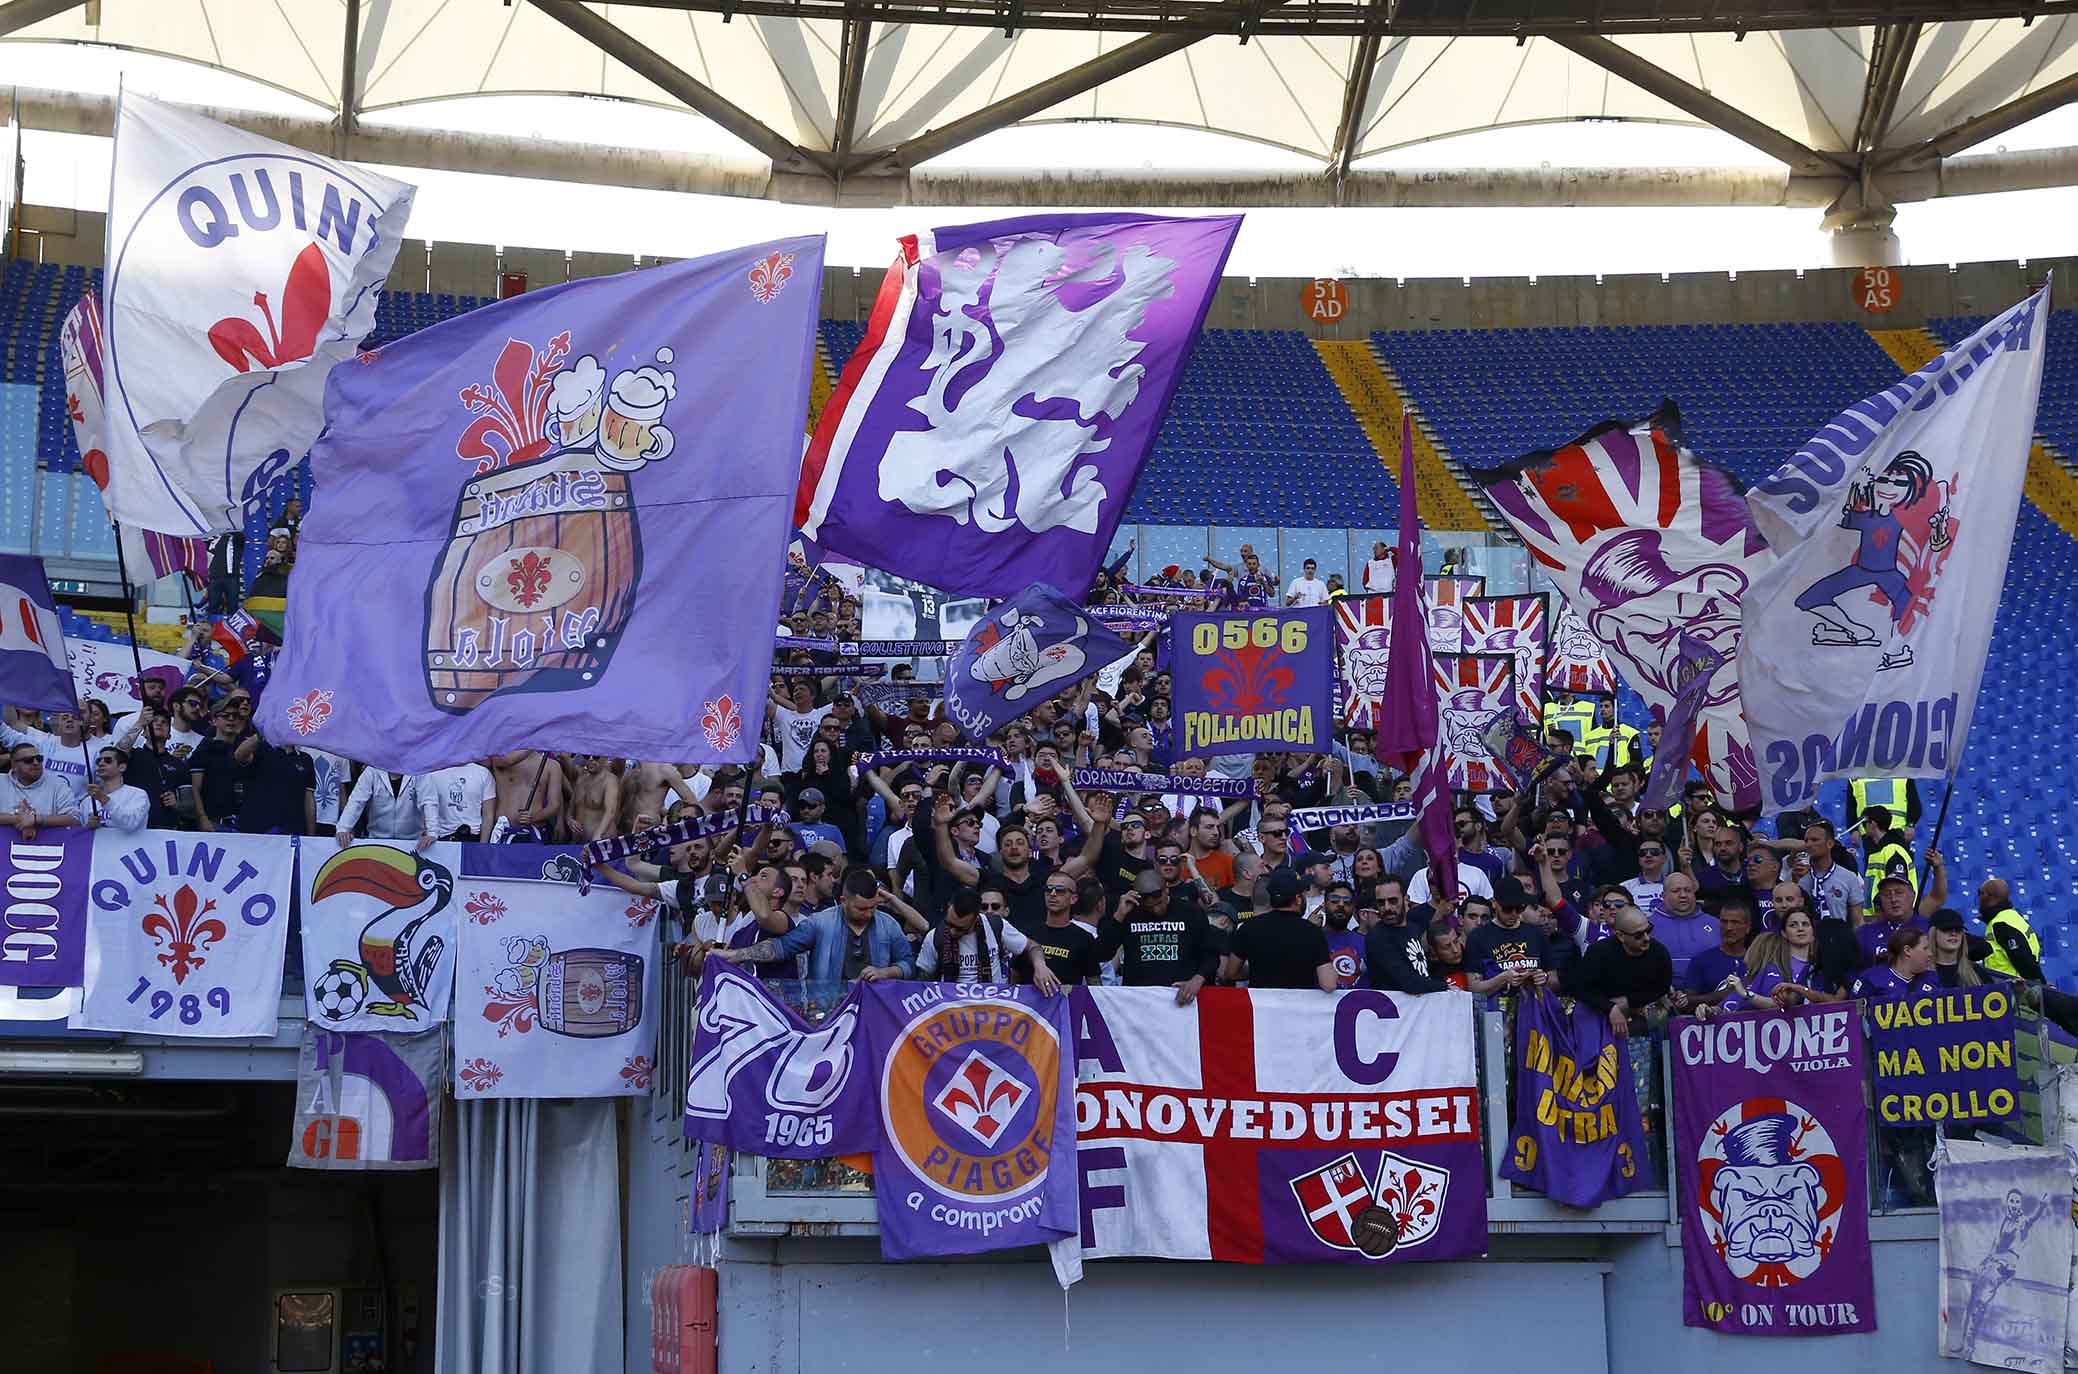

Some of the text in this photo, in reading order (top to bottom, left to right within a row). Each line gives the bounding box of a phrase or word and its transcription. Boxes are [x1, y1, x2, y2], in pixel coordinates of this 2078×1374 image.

[1314, 280, 1337, 298] 51
[1864, 269, 1889, 288] 50
[1312, 300, 1342, 318] AD
[1864, 289, 1891, 308] AS
[921, 598, 935, 615] 13
[1091, 606, 1168, 620] ACF FIORENTINA
[860, 641, 945, 656] COLLETTIVO
[1192, 617, 1308, 655] 0566
[1184, 706, 1315, 752] FOLLONICA
[1173, 775, 1247, 794] POGGETTO
[91, 840, 276, 926] QUINTO
[2, 841, 64, 965] DOCG
[1130, 921, 1186, 933] DIRECTIVO
[1139, 933, 1179, 944] ULTRAS
[1140, 944, 1179, 961] XXI
[127, 976, 231, 1025] 1989
[901, 981, 1021, 1015] mai scesi
[1874, 991, 2009, 1030] VACILLO
[911, 1010, 1032, 1058] GRUPPO
[1334, 989, 1400, 1086] C
[1679, 1011, 1850, 1074] CICLONE
[1790, 1055, 1852, 1073] VIOLA
[1878, 1039, 2012, 1078] MA NON
[1880, 1088, 2015, 1124] CROLLO
[764, 1112, 833, 1147] 1965
[1514, 1136, 1537, 1172] 9
[906, 1190, 1046, 1237] a comprom
[1741, 1303, 1774, 1326] ON
[1785, 1303, 1860, 1326] TOUR
